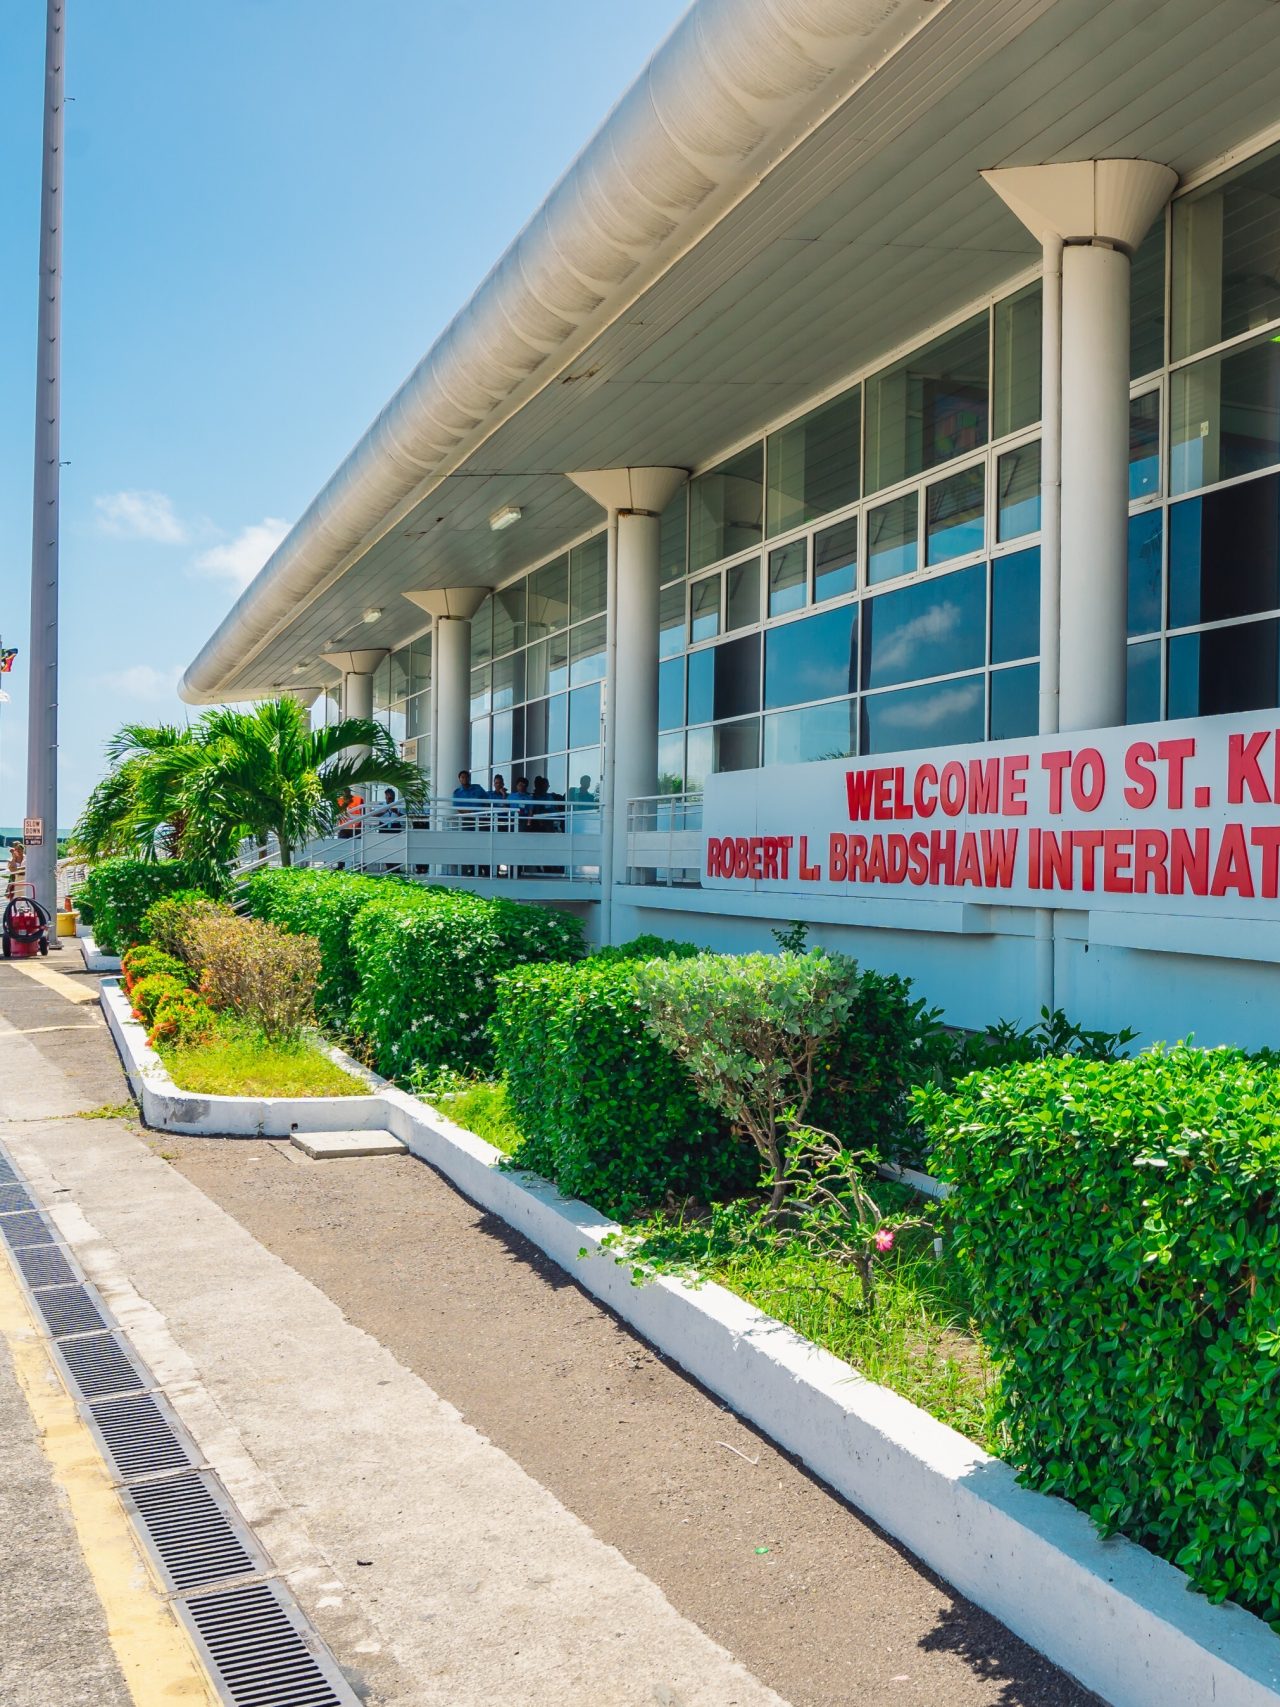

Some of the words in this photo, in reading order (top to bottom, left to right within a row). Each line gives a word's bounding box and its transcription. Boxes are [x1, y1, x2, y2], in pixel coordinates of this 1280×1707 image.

[845, 755, 1028, 822] WELCOME
[1041, 748, 1106, 814] TO
[1123, 738, 1211, 809] ST.
[706, 836, 793, 880] ROBERT
[799, 836, 821, 881] L.
[829, 827, 1019, 888] BRADSHAW
